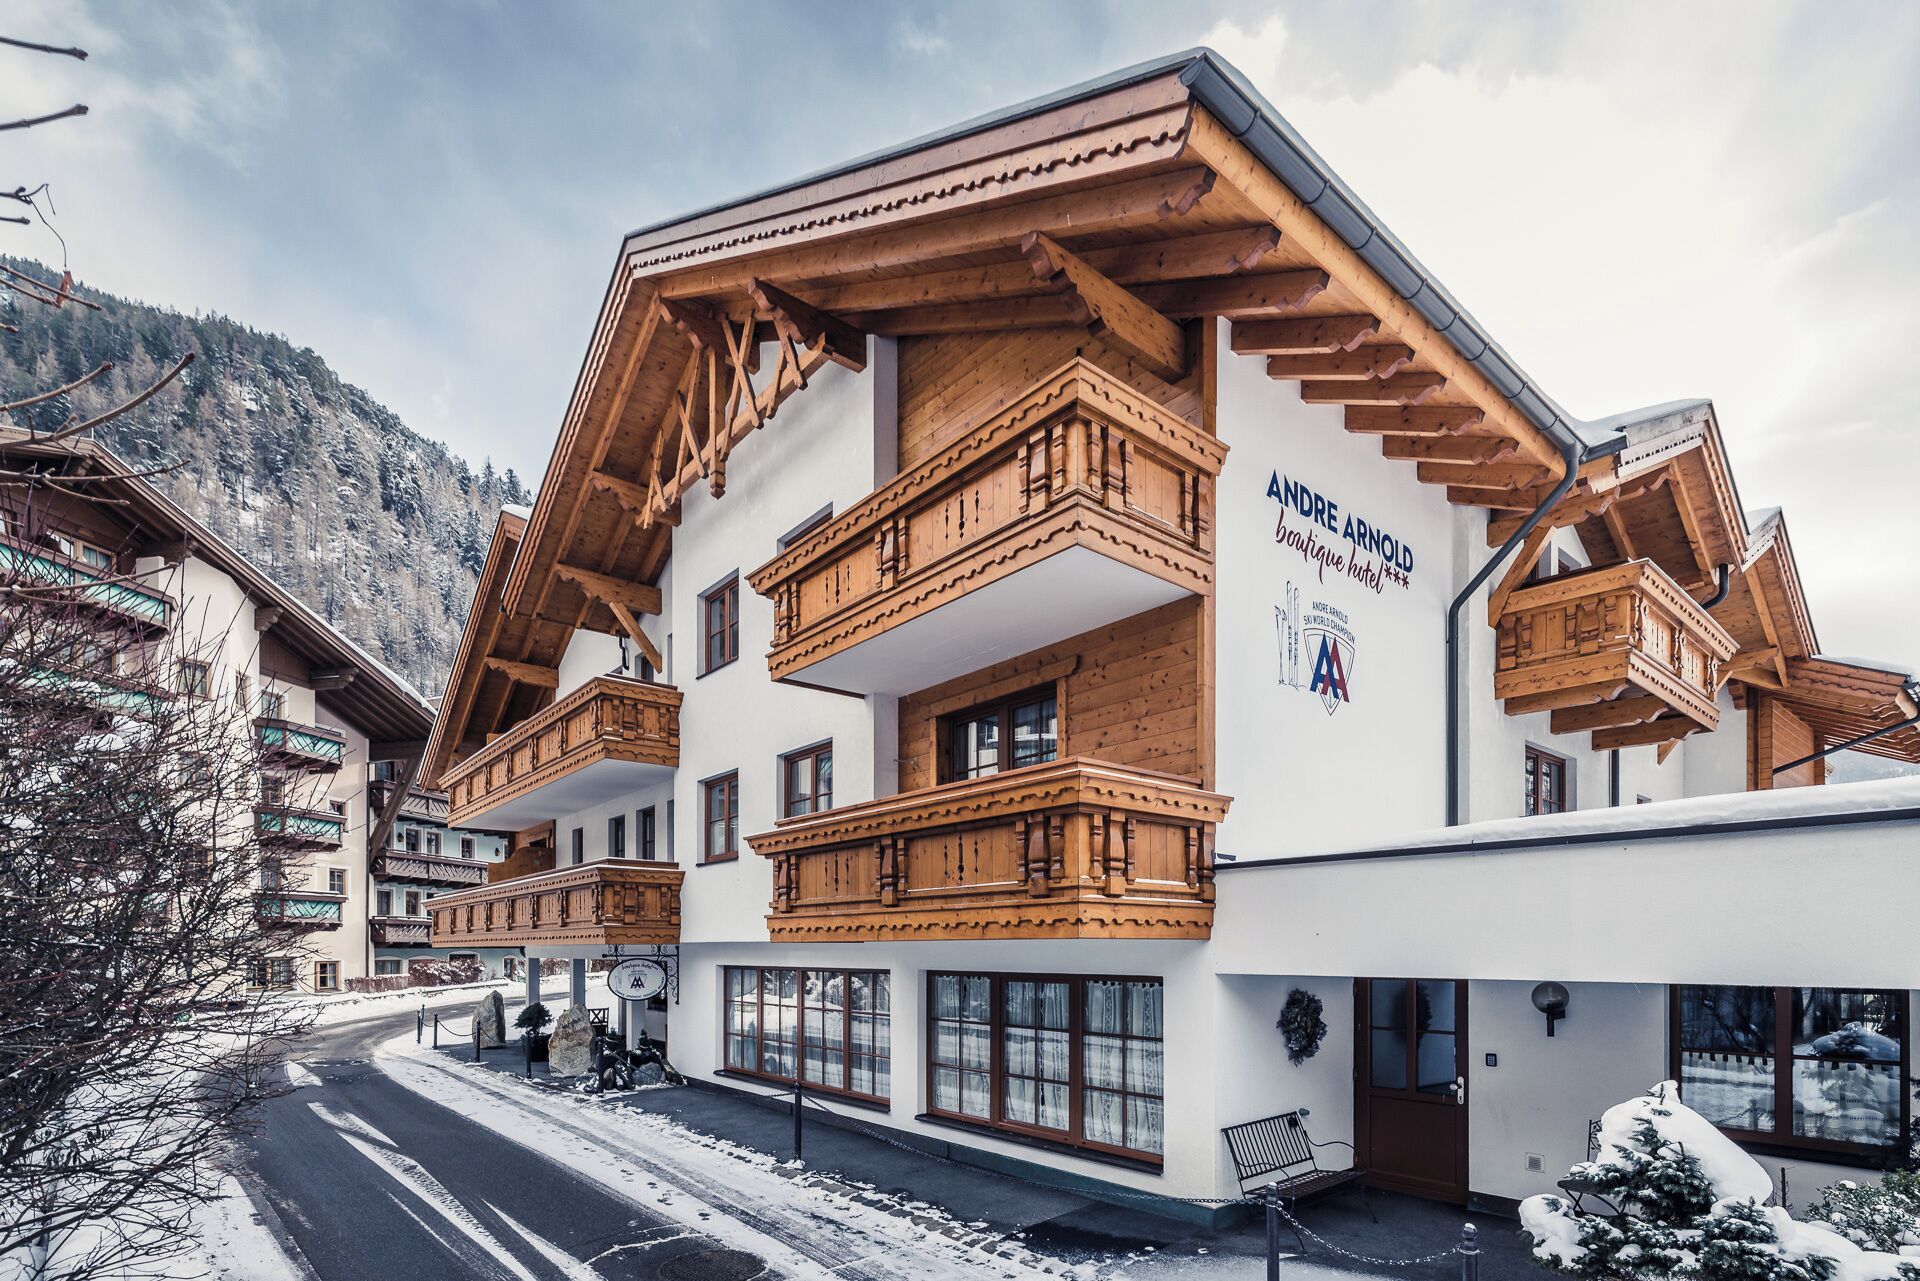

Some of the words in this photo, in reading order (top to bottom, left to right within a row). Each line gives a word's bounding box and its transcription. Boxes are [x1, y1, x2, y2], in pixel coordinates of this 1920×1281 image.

[1266, 468, 1338, 534] ANDRE
[1342, 512, 1414, 573] ARNOLD
[1275, 506, 1346, 585] boutique
[1303, 615, 1313, 625] SKI
[1313, 615, 1330, 627] WORLD
[1331, 620, 1356, 644] CHAMPION
[1312, 601, 1328, 614] ANDRE
[1329, 606, 1349, 625] ARNOLD
